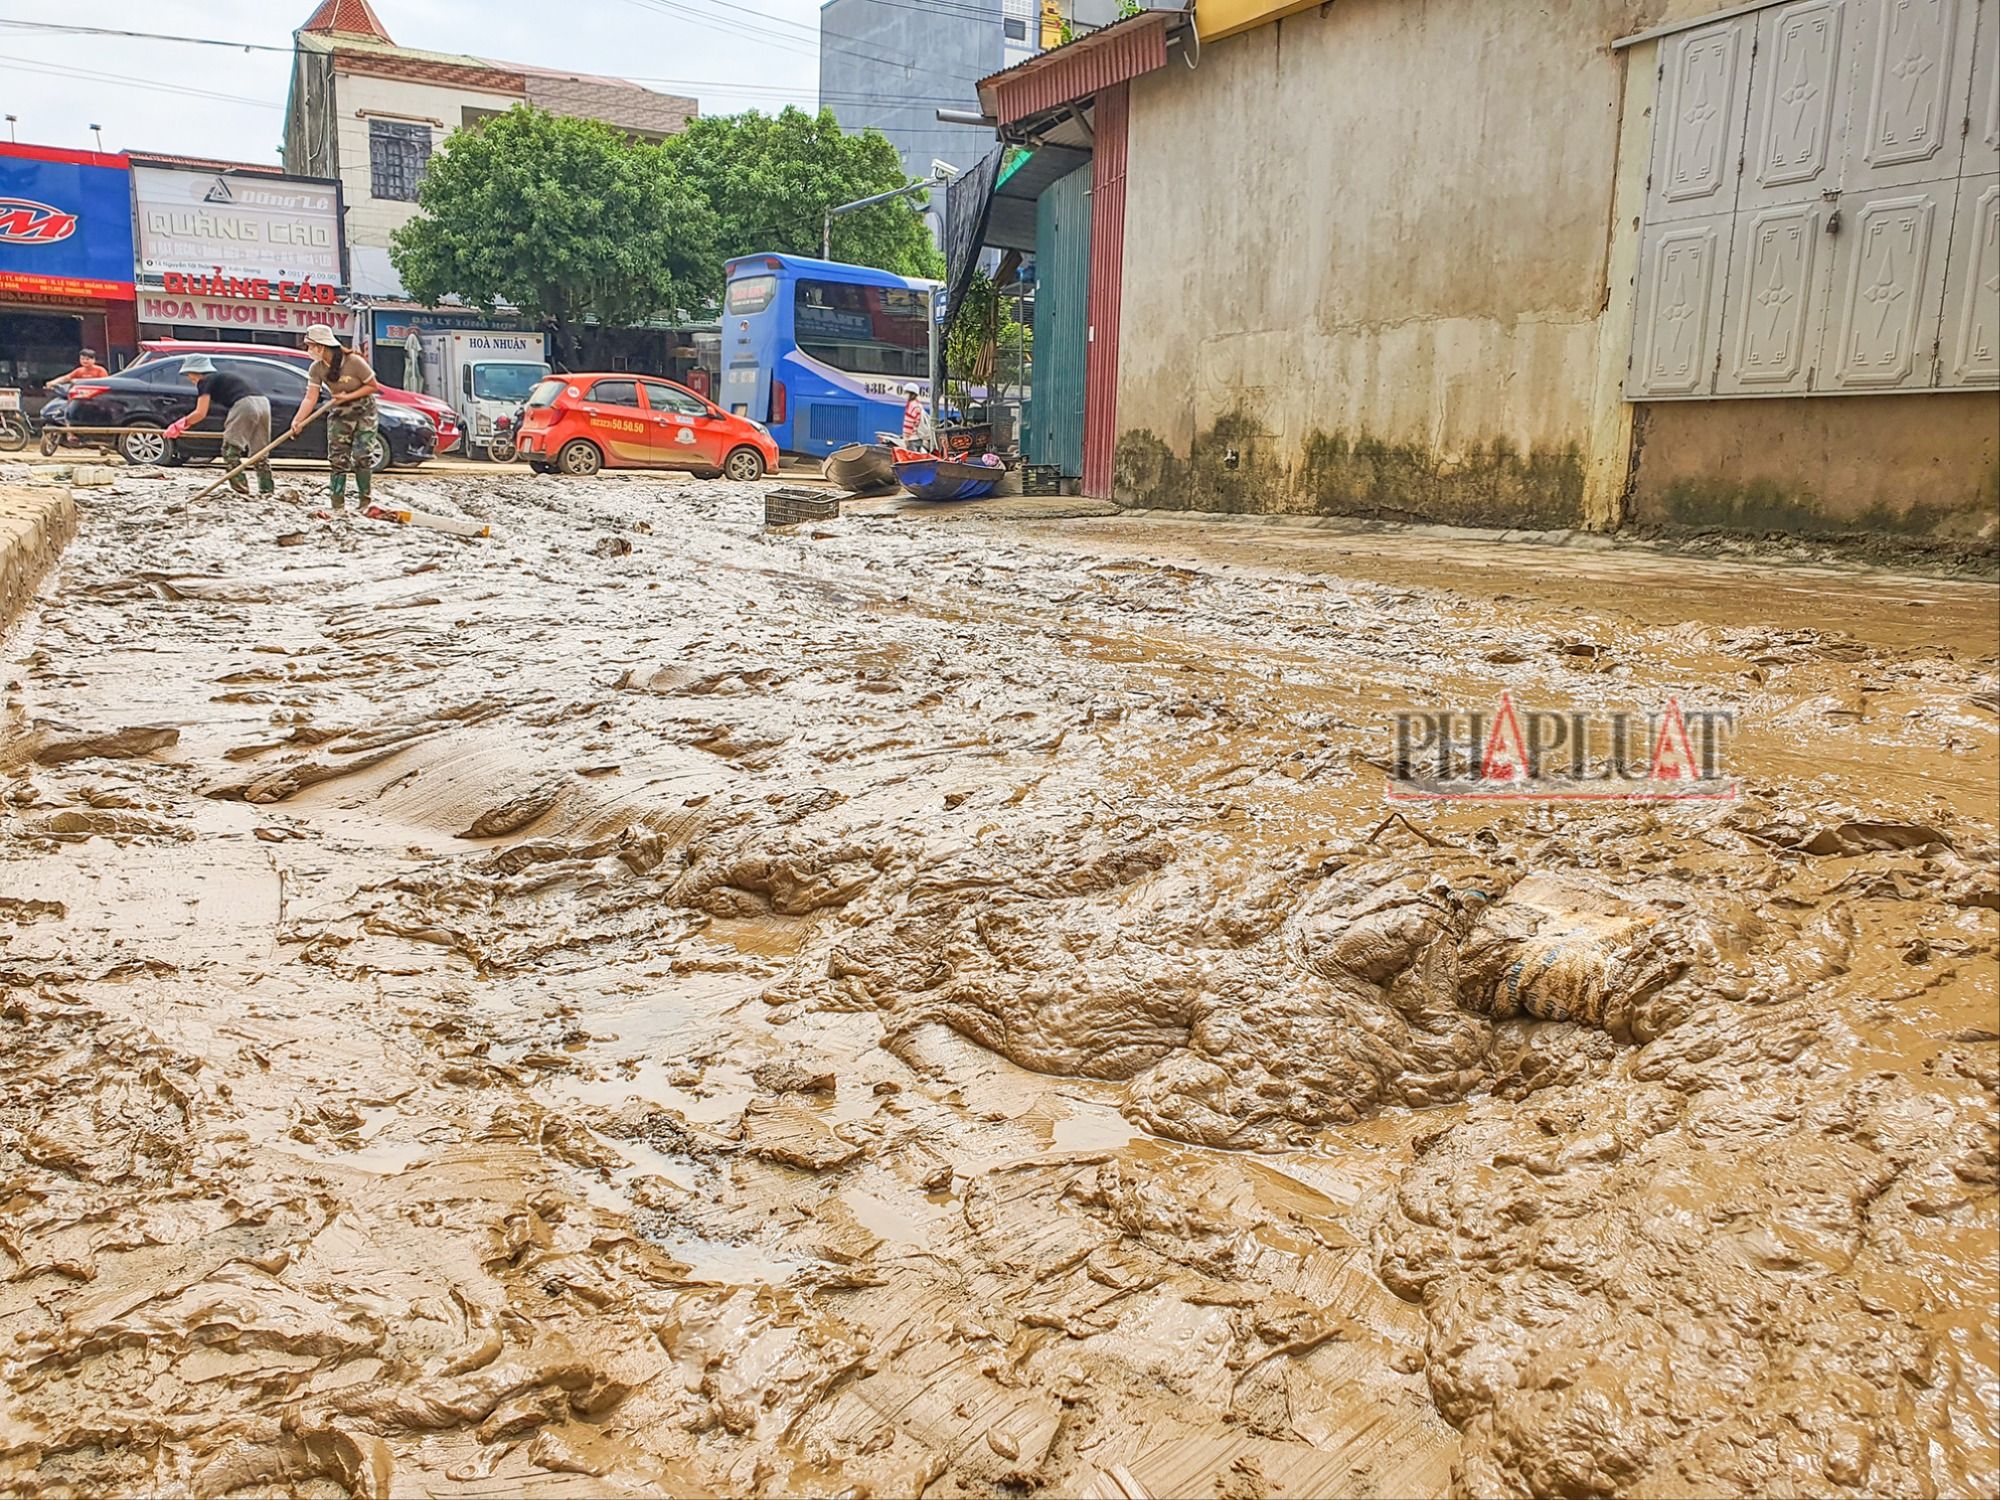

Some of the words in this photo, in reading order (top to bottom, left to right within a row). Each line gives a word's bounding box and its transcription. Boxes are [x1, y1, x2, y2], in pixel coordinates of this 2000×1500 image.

[268, 218, 331, 248] CÁO
[163, 266, 270, 300] QUẢNG
[278, 275, 338, 306] CÁO
[144, 298, 198, 320] HOA
[202, 302, 259, 323] TƯƠI
[292, 307, 349, 330] THỦY
[493, 337, 527, 352] NHUẬN
